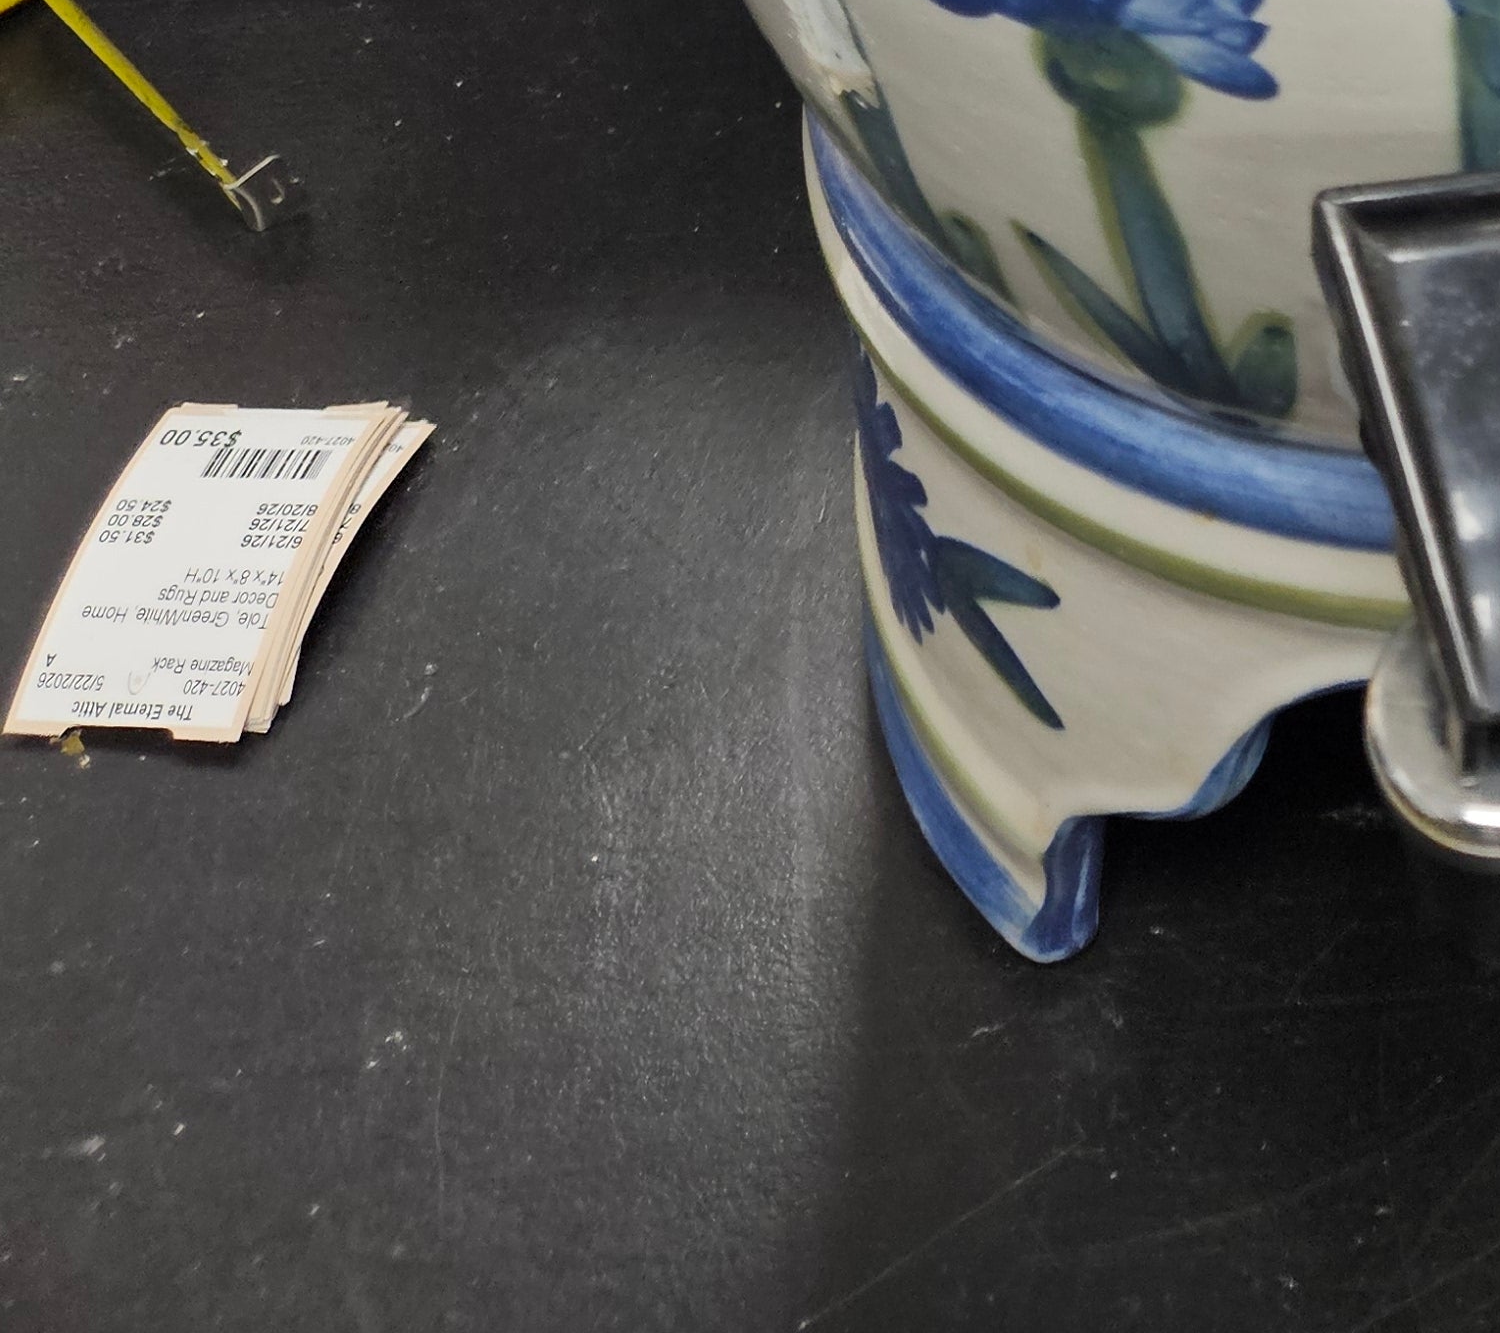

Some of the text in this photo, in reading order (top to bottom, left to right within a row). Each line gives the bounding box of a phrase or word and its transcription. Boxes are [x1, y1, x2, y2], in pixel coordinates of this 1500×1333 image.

[159, 428, 243, 448] $35.00
[116, 499, 319, 515] 8/20/26 $24.50
[107, 514, 311, 532] 7/21/26 $28.00
[98, 529, 304, 549] 6/21/26 $31.50
[157, 584, 279, 609] Decor and Rugs
[81, 605, 129, 623] Home
[46, 653, 57, 668] A
[151, 656, 255, 676] Magazine Rack
[37, 671, 246, 697] 4027-420 5/22/2026
[71, 700, 193, 721] The Eternal Attic
